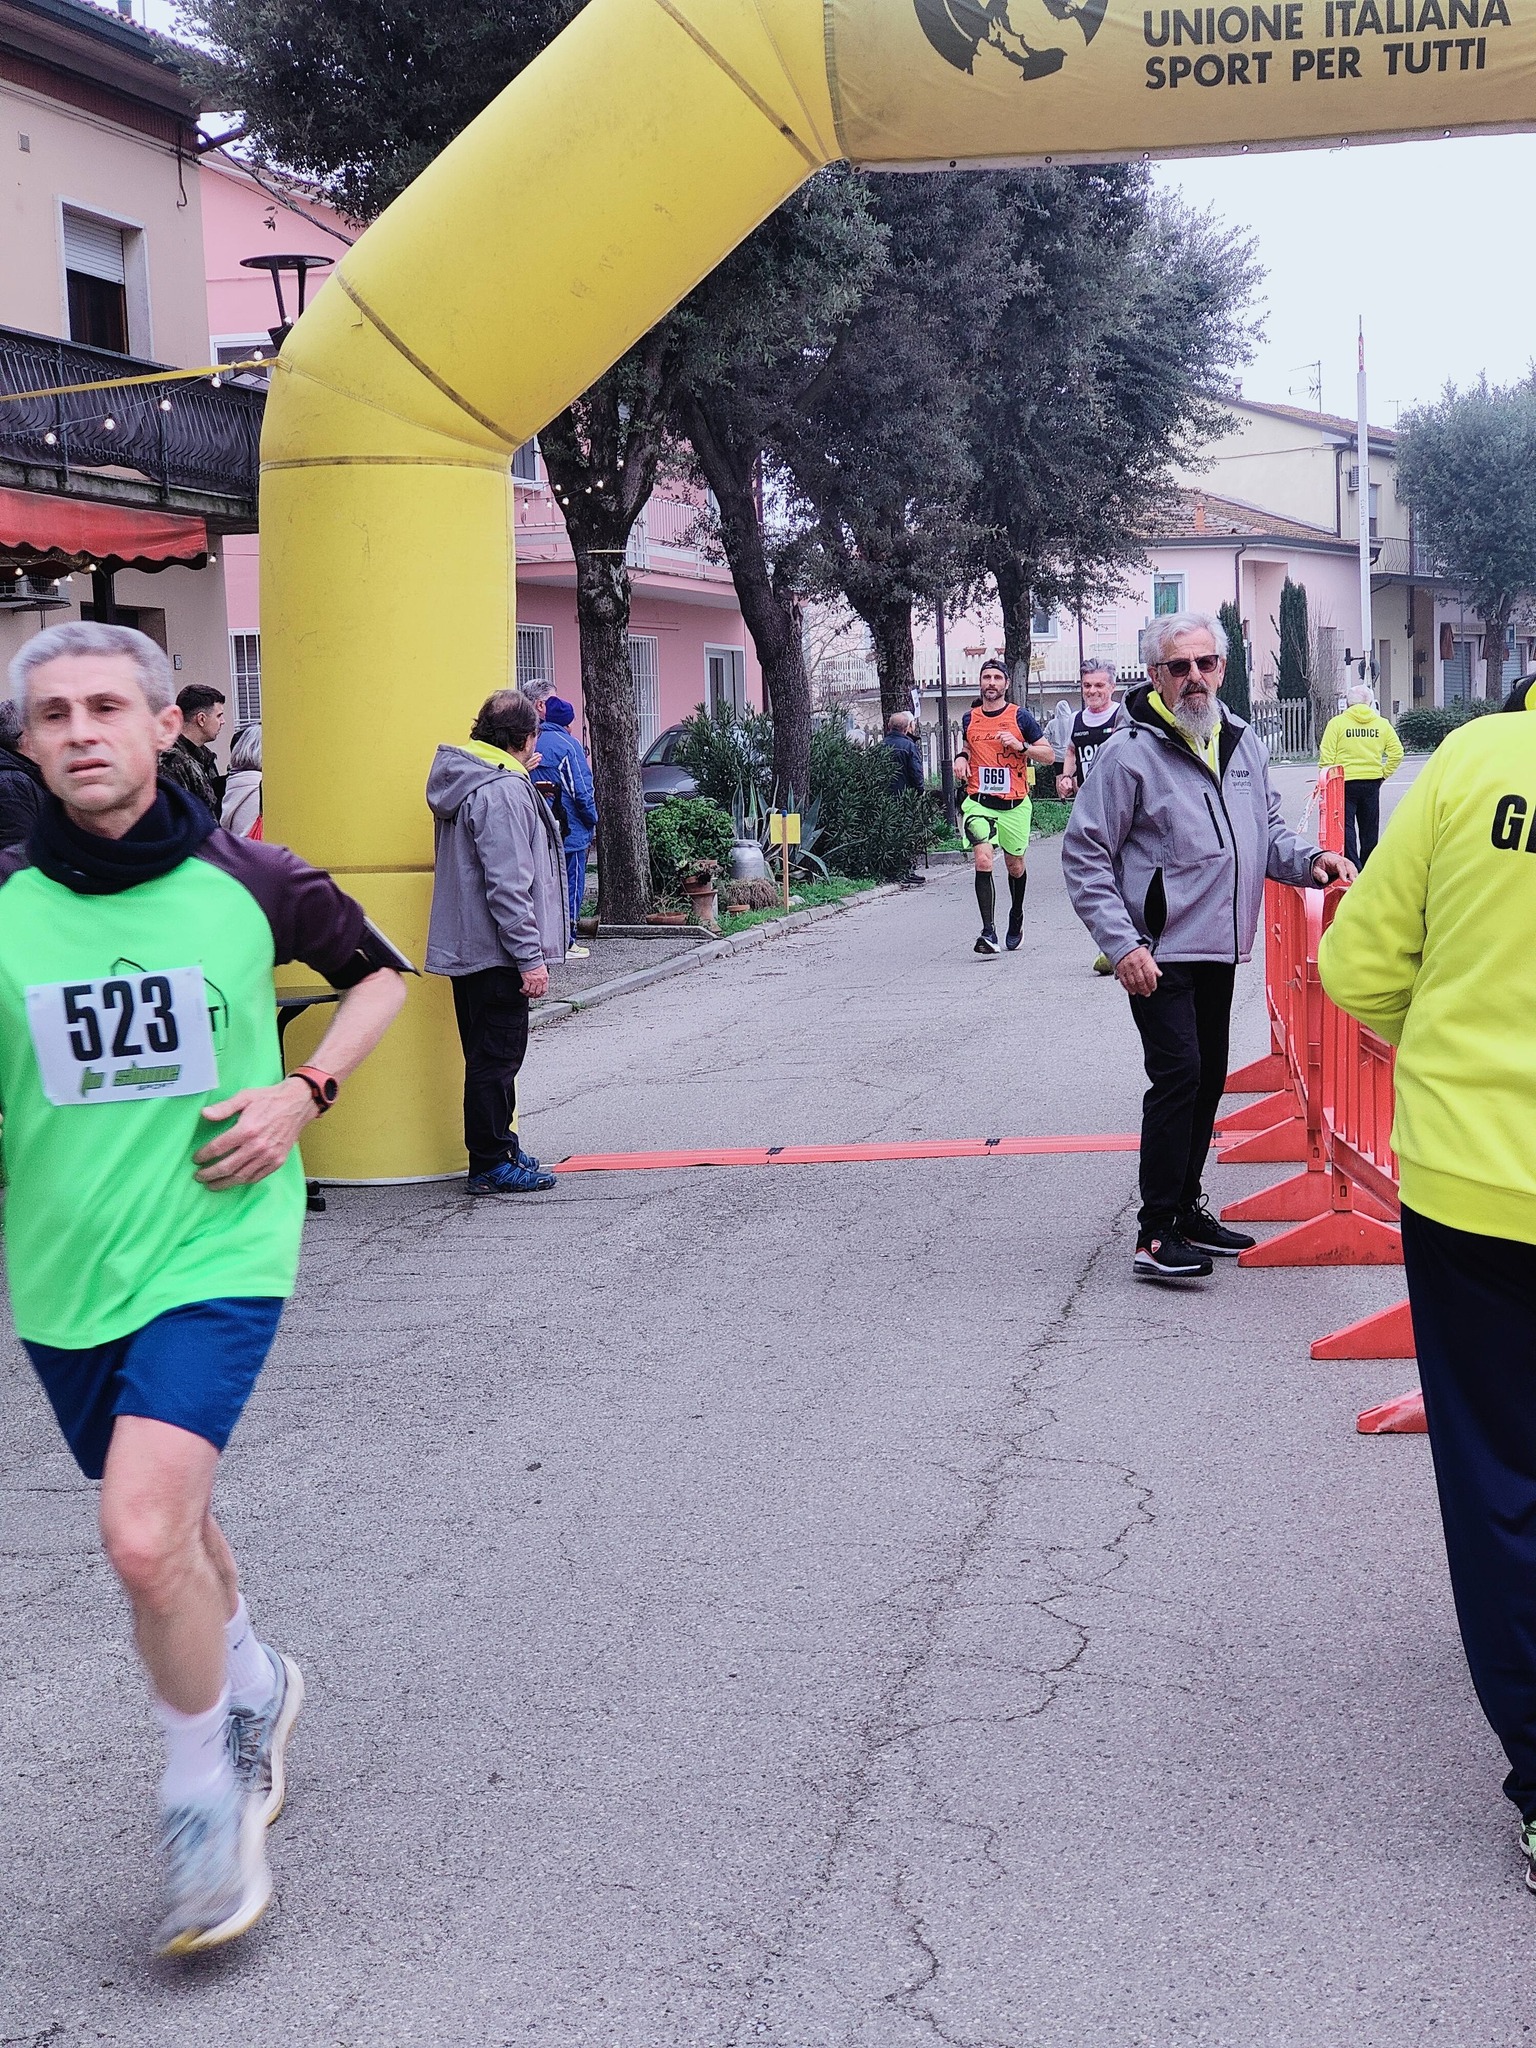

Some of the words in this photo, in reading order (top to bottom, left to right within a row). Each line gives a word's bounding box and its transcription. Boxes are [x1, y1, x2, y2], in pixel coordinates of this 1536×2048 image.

[1143, 3, 1302, 47] UNIONE
[1325, 0, 1512, 38] ITALIANA
[1145, 51, 1273, 90] SPORT
[1292, 46, 1363, 82] PER
[1383, 37, 1487, 76] TUTTI
[1346, 728, 1380, 738] GIUDICE
[984, 768, 1005, 785] 669
[62, 975, 179, 1062] 523
